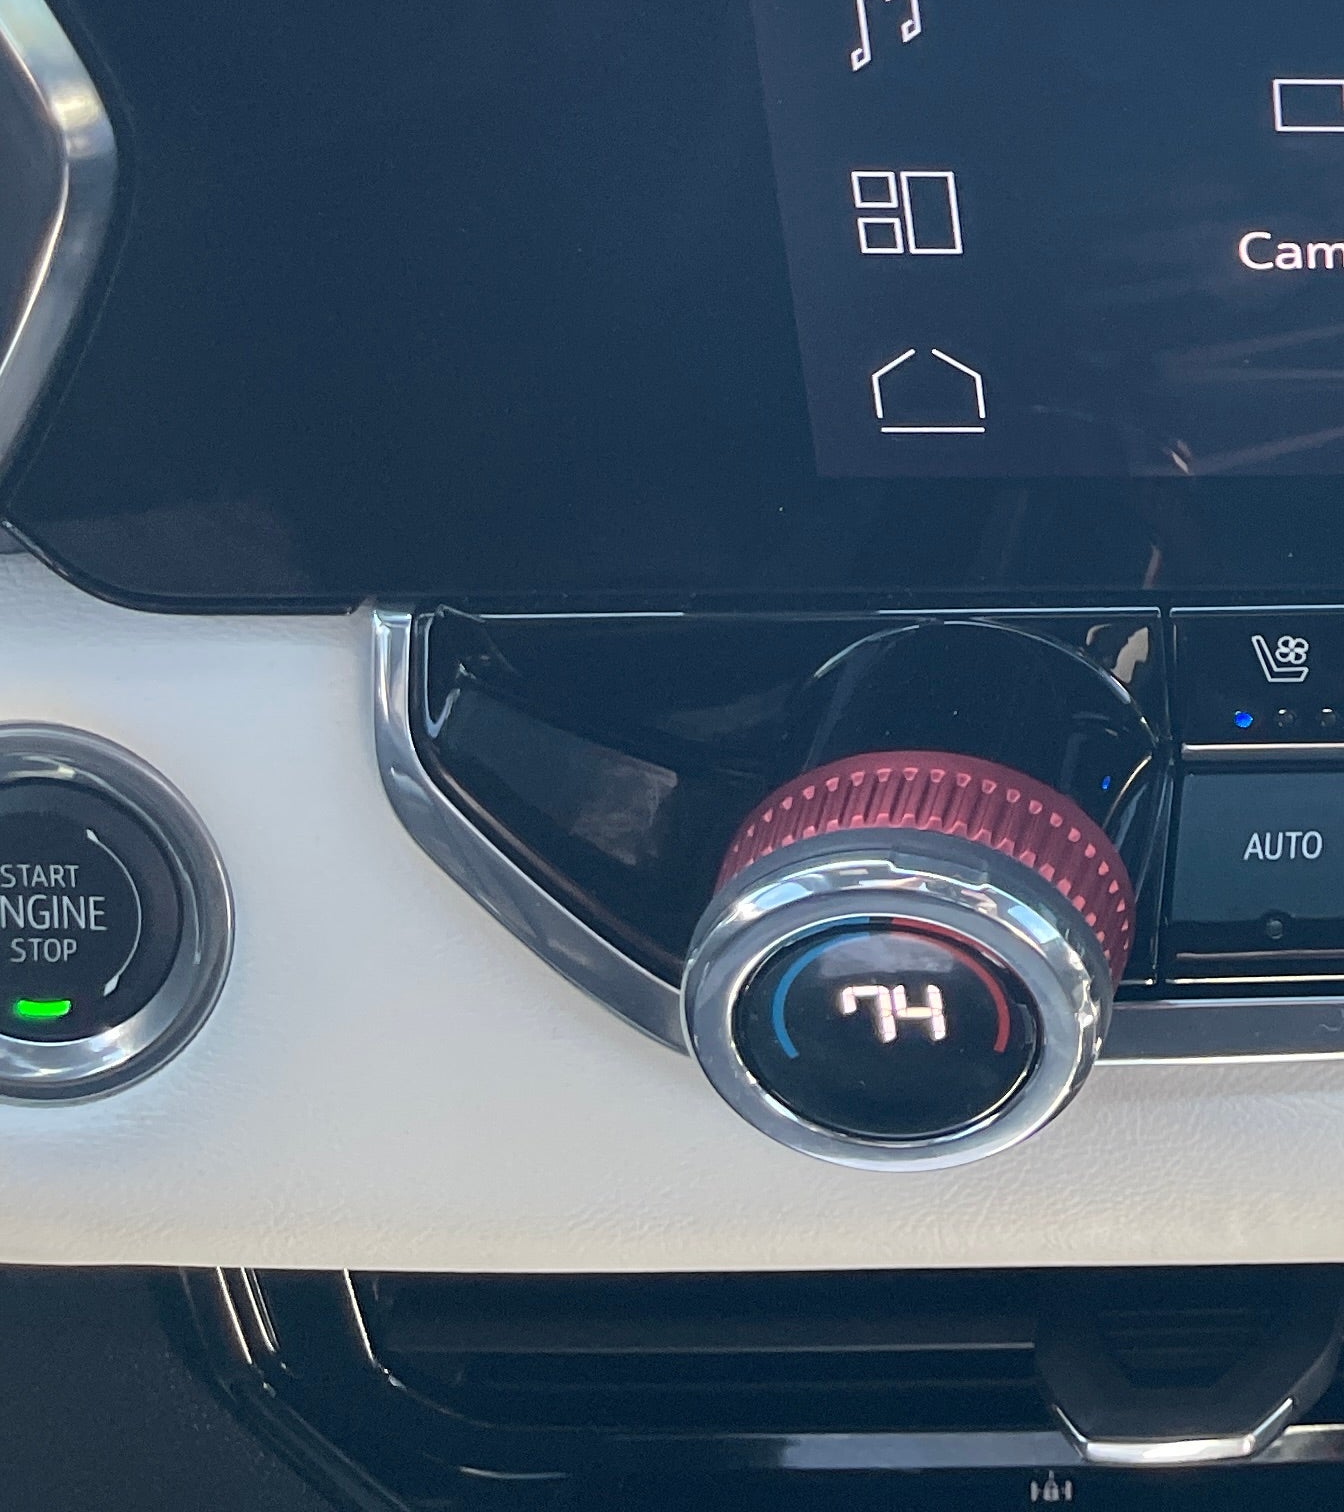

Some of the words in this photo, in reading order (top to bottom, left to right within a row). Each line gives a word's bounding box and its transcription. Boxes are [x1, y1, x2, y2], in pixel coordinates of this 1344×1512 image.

[1243, 830, 1323, 861] AUTO
[0, 863, 80, 888] START
[0, 893, 108, 931] NGINE
[9, 937, 78, 963] STOP
[838, 984, 947, 1044] 74
